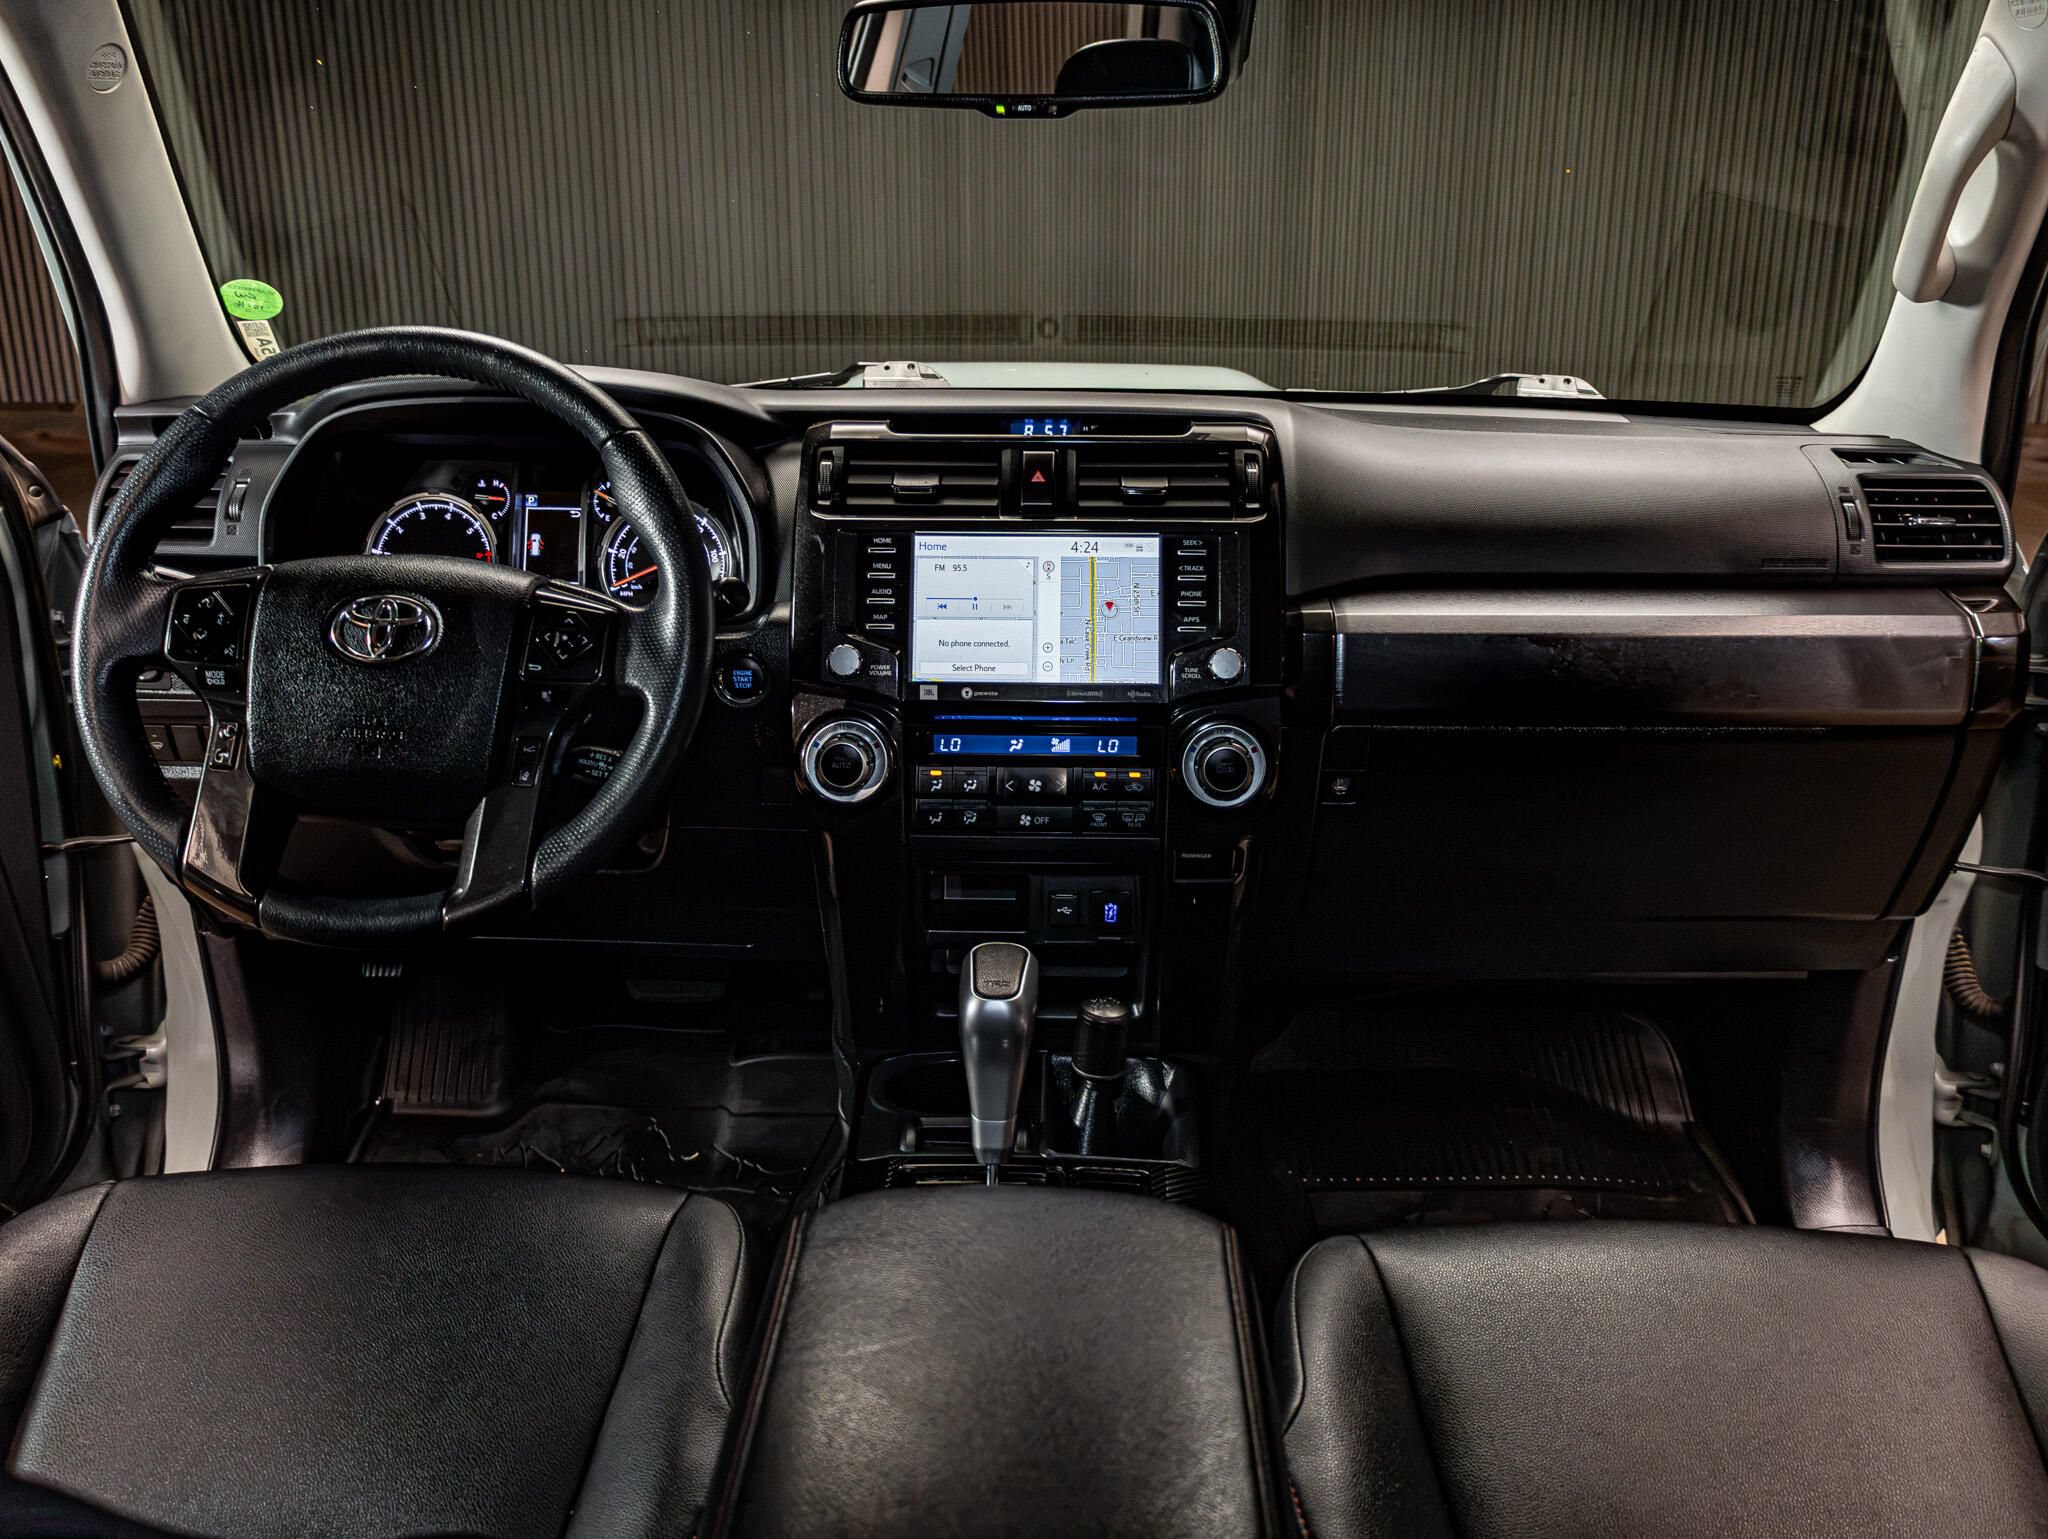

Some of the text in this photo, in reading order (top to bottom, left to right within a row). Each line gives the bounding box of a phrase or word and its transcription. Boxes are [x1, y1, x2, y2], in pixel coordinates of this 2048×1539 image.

[1017, 104, 1032, 112] AUTO
[419, 512, 427, 520] 3
[444, 512, 452, 520] 4
[604, 514, 611, 522] E
[395, 526, 405, 534] 2
[919, 541, 947, 551] Home
[1070, 541, 1099, 554] 4:24
[618, 548, 627, 560] 20
[710, 548, 719, 563] 100
[934, 564, 968, 572] FM 95.5
[1180, 590, 1202, 598] PHONE
[938, 639, 1010, 649] No phone connected.
[952, 663, 996, 672] Select Phone
[205, 670, 225, 678] MODE
[940, 738, 962, 752] LO
[1097, 739, 1119, 753] LO
[1092, 783, 1108, 791] A/C
[1034, 816, 1050, 825] OFF
